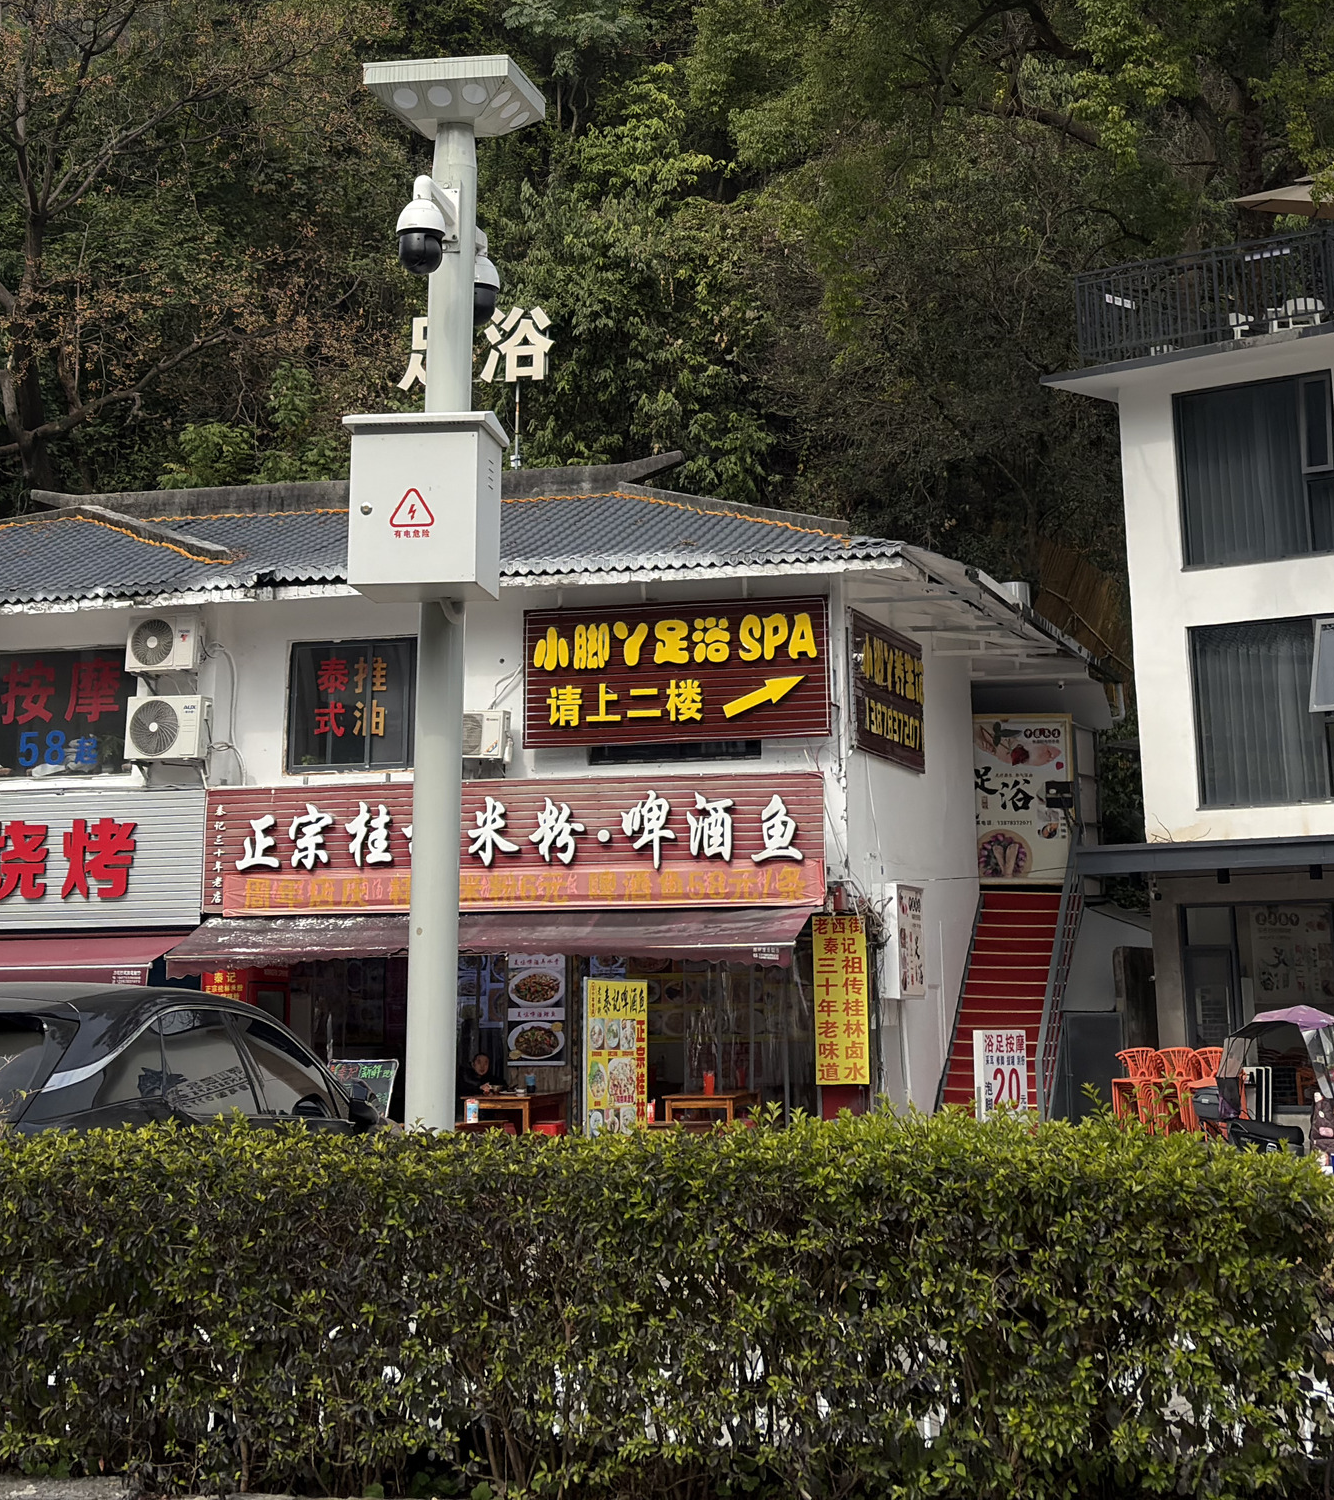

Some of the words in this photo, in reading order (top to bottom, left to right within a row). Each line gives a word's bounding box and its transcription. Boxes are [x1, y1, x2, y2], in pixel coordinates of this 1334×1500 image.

[394, 529, 431, 539] 有电危险
[0, 658, 121, 725] 按摩
[314, 657, 349, 738] 泰式
[352, 657, 387, 738] 推油
[546, 679, 704, 726] 请上二楼
[18, 730, 97, 767] 58起
[974, 766, 1034, 812] 足浴
[235, 790, 806, 873] 正宗桂米粉·啤酒鱼
[389, 871, 567, 908] 桂米粉6元
[813, 917, 865, 935] 老西街
[823, 937, 857, 955] 秦记
[816, 957, 840, 1082] 三十年老味道
[842, 956, 866, 1081] 祖传桂林卤水
[984, 1034, 1025, 1053] 浴足按摩
[635, 1019, 646, 1129] 正宗桂林
[993, 1067, 1021, 1111] 20
